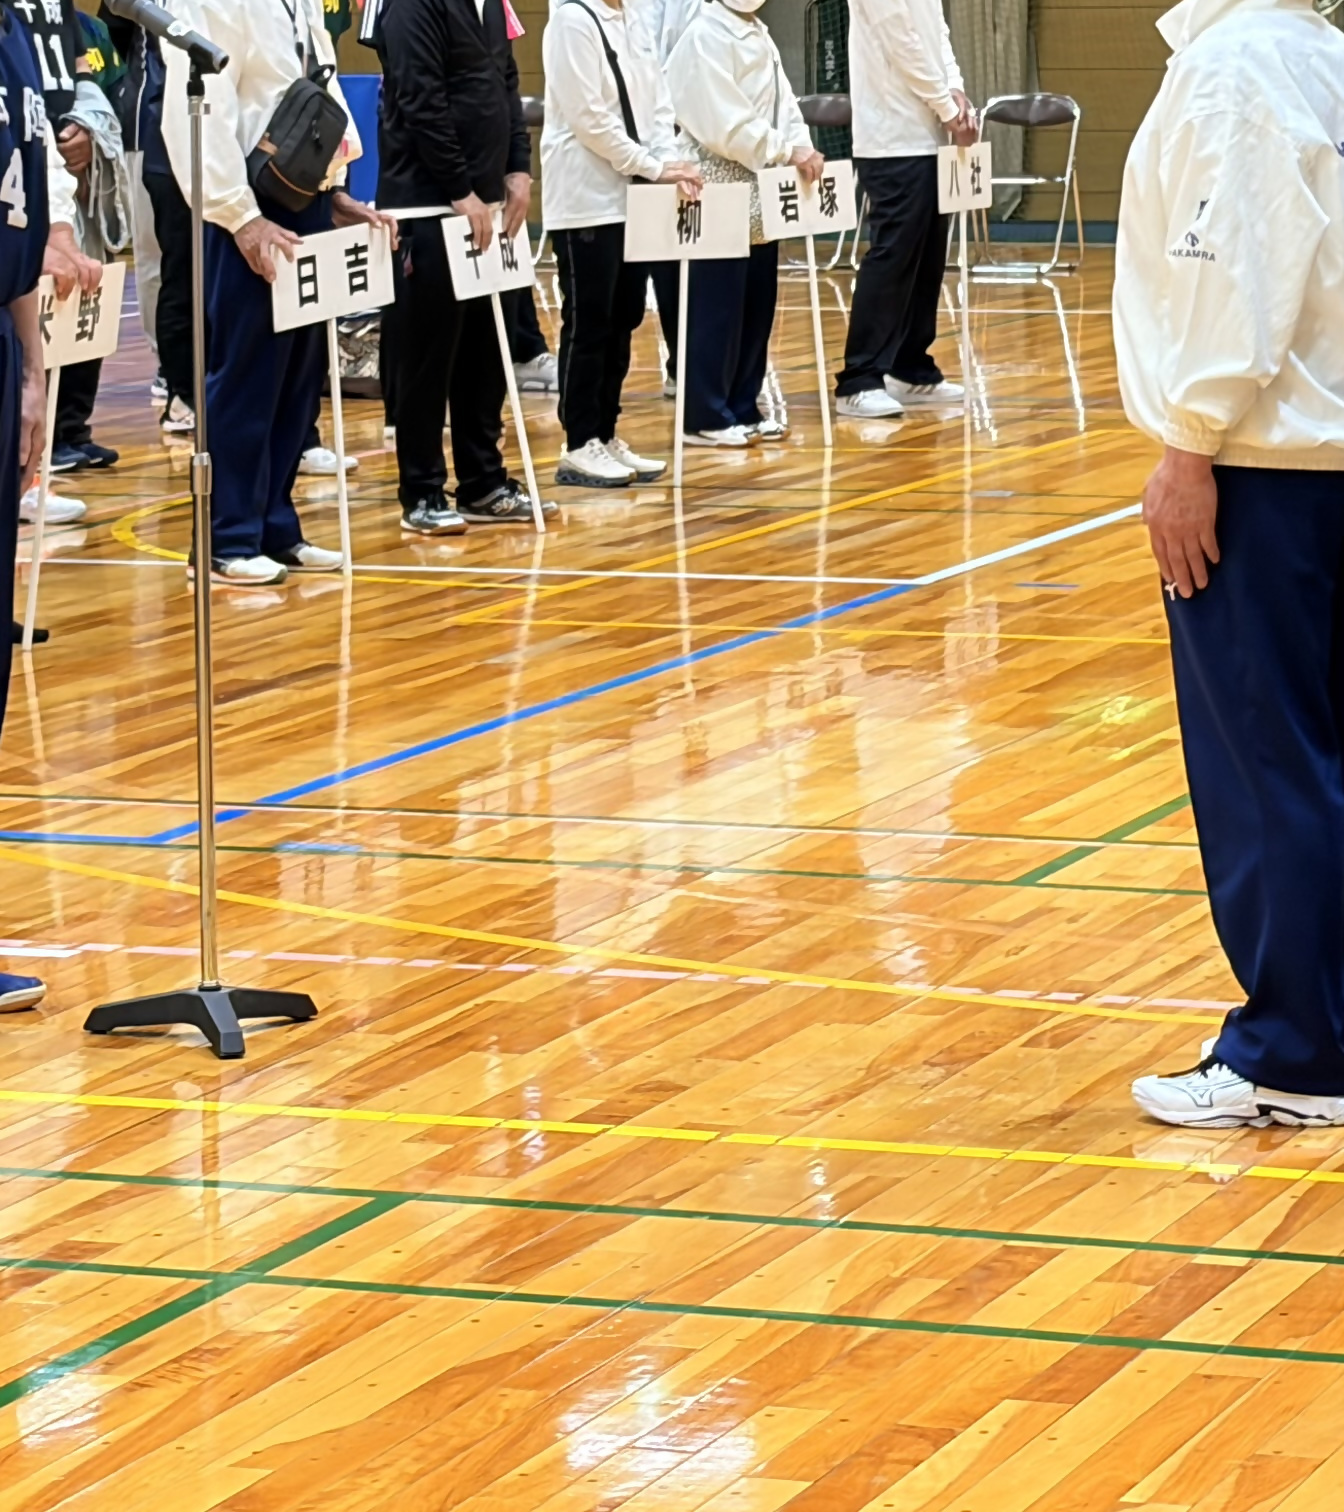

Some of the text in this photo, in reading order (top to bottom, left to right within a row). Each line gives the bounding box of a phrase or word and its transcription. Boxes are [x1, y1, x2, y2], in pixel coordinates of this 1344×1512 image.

[33, 33, 75, 91] 11
[677, 199, 702, 245] 柳
[777, 176, 840, 224] 岩塚
[296, 242, 369, 308] 日吉
